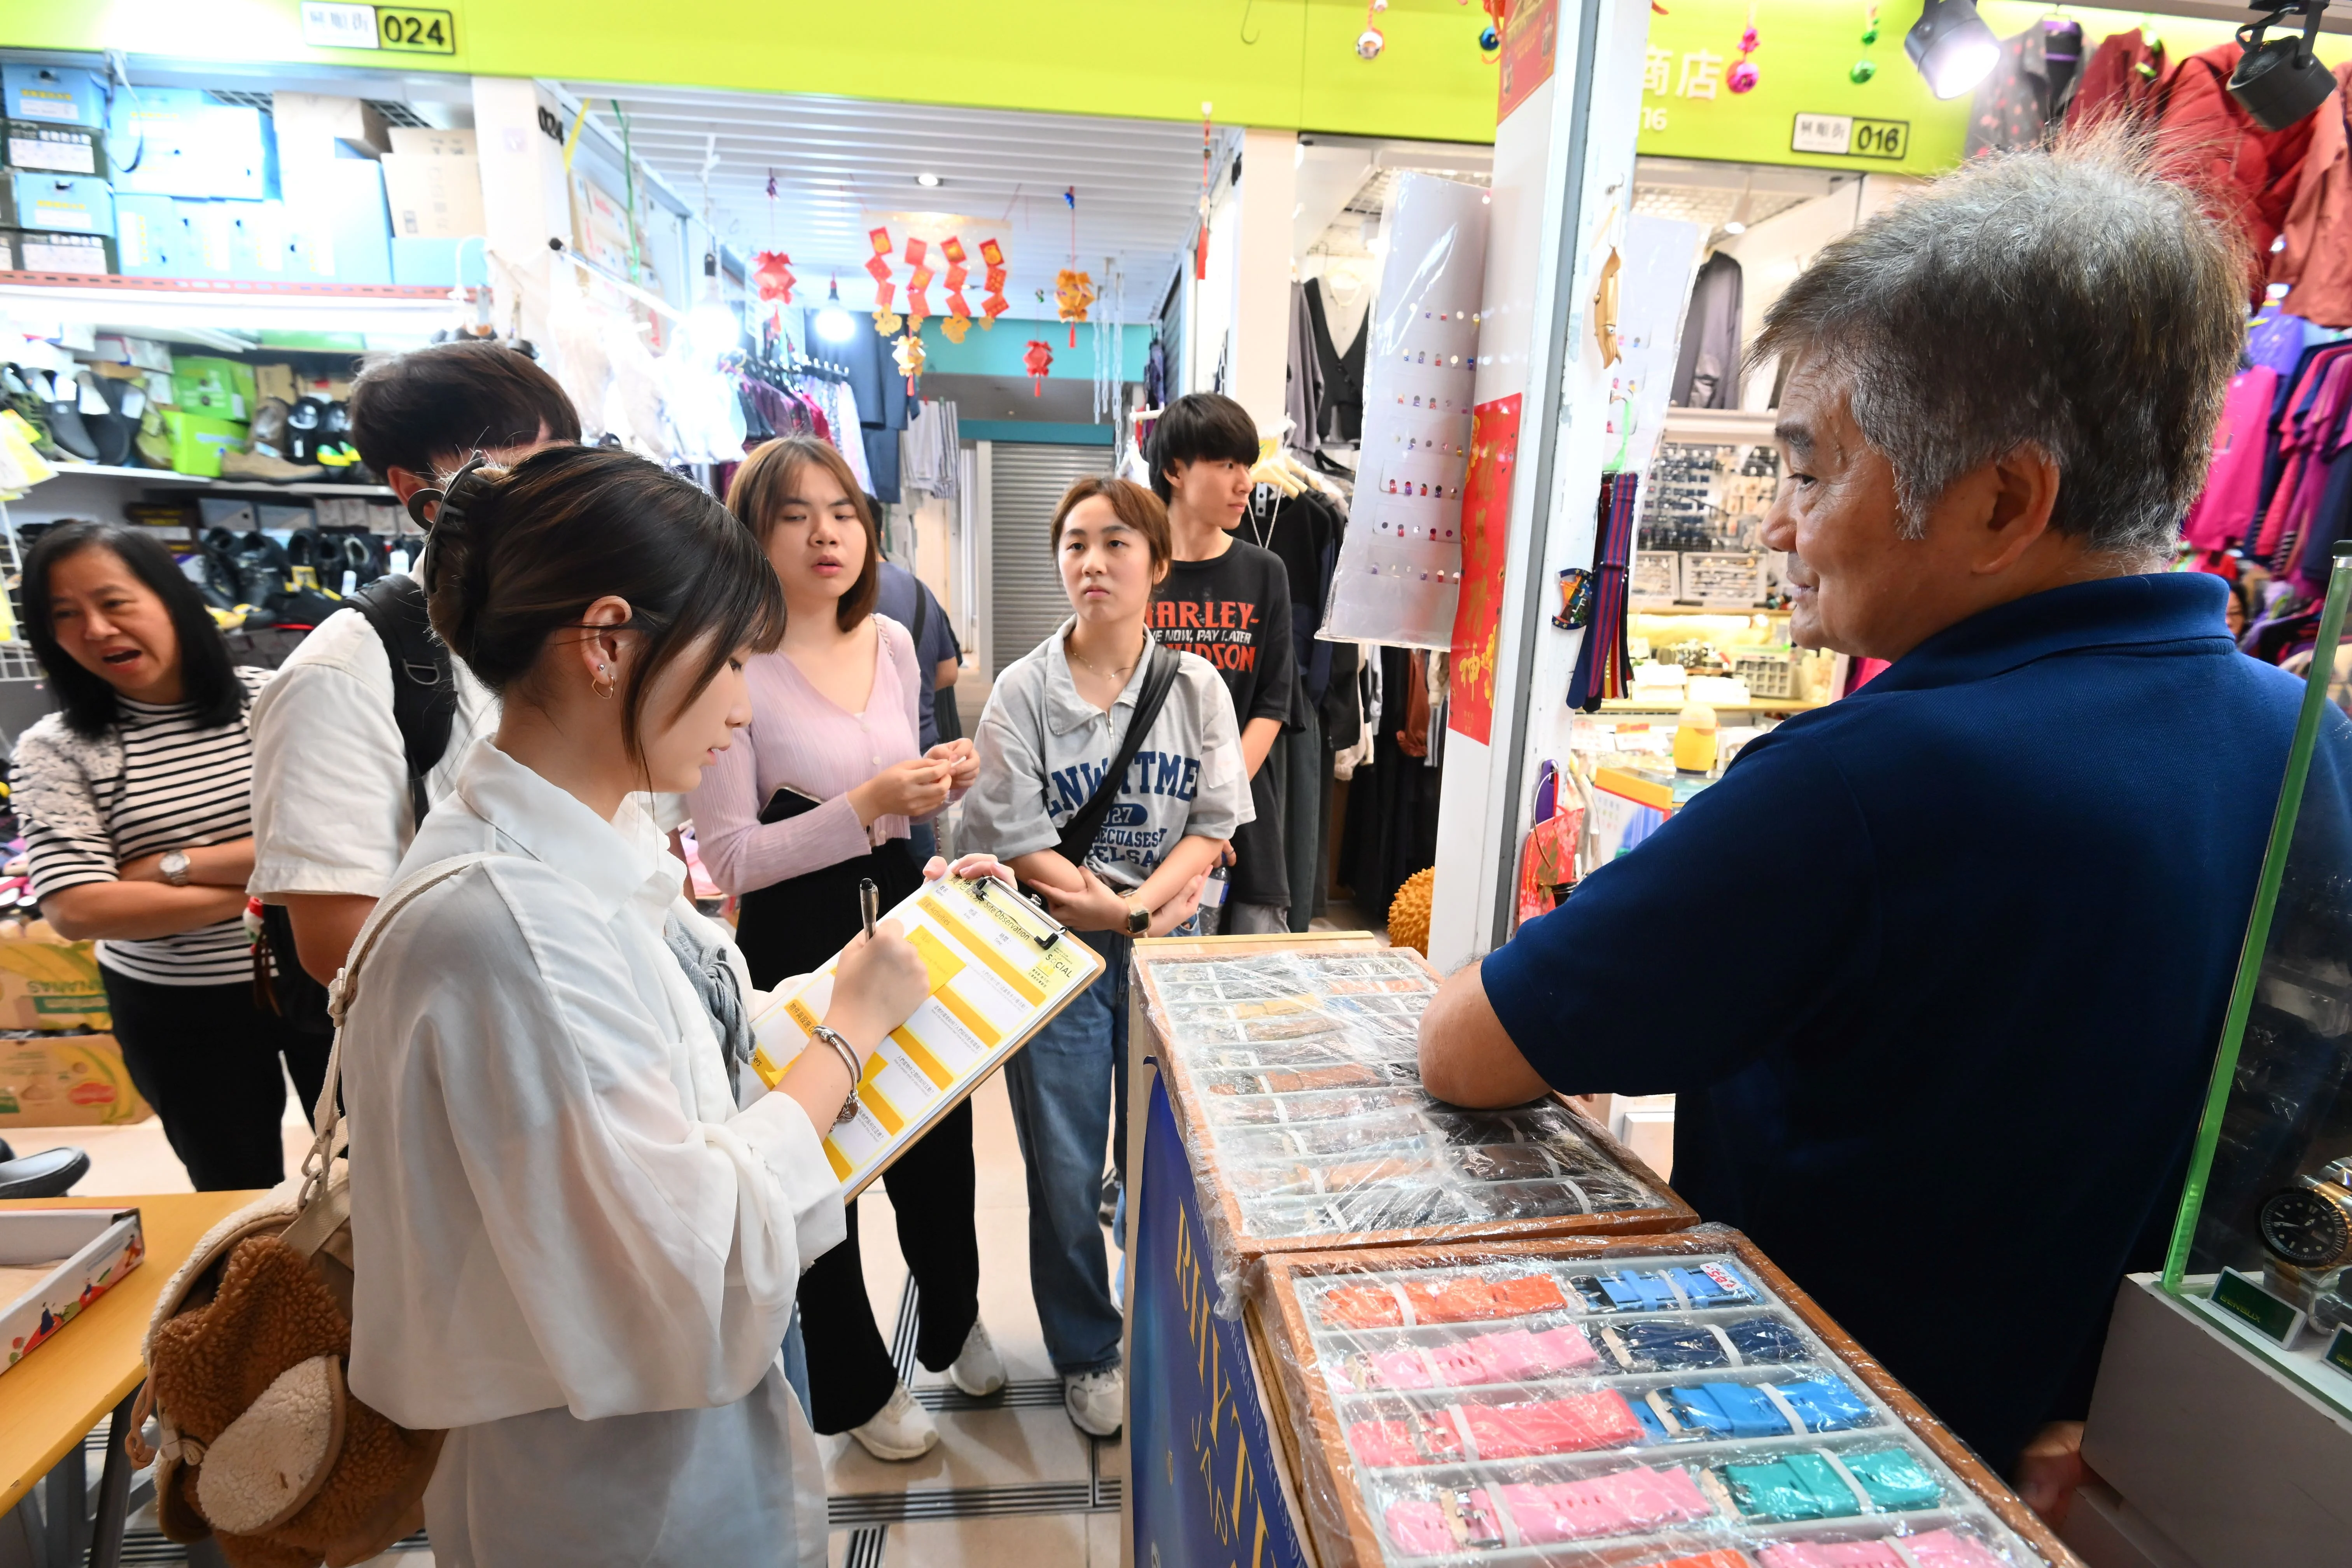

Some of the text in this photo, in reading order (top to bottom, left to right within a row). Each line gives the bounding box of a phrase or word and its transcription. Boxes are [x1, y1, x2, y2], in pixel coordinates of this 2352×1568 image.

[385, 15, 445, 46] 024
[1858, 124, 1899, 152] 016
[1164, 630, 1193, 643] NOW,
[1196, 630, 1219, 642] PAY
[1221, 630, 1252, 644] LATER
[930, 906, 950, 926] Activities
[984, 901, 1030, 941] Site Observation
[1045, 954, 1072, 978] SOCIAL
[789, 1003, 812, 1029] 物件與設施
